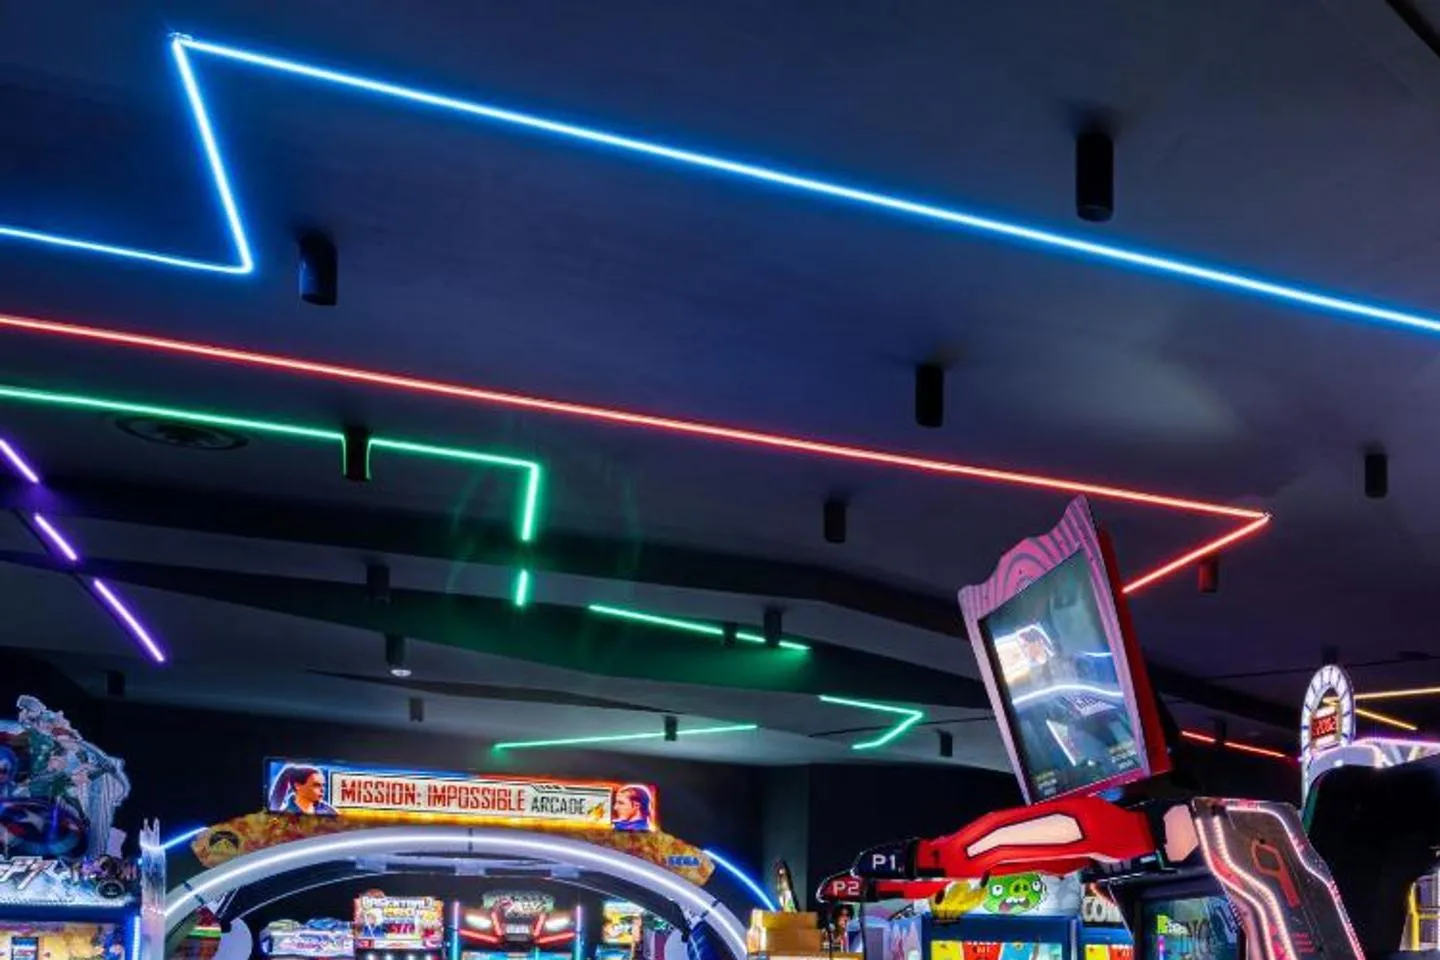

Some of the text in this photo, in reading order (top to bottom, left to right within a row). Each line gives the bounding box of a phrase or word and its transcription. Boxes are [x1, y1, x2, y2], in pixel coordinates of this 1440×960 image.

[339, 778, 586, 816] MISSION: IMPOSSIBLE ARCADE
[872, 854, 897, 871] P1
[833, 881, 861, 896] P2
